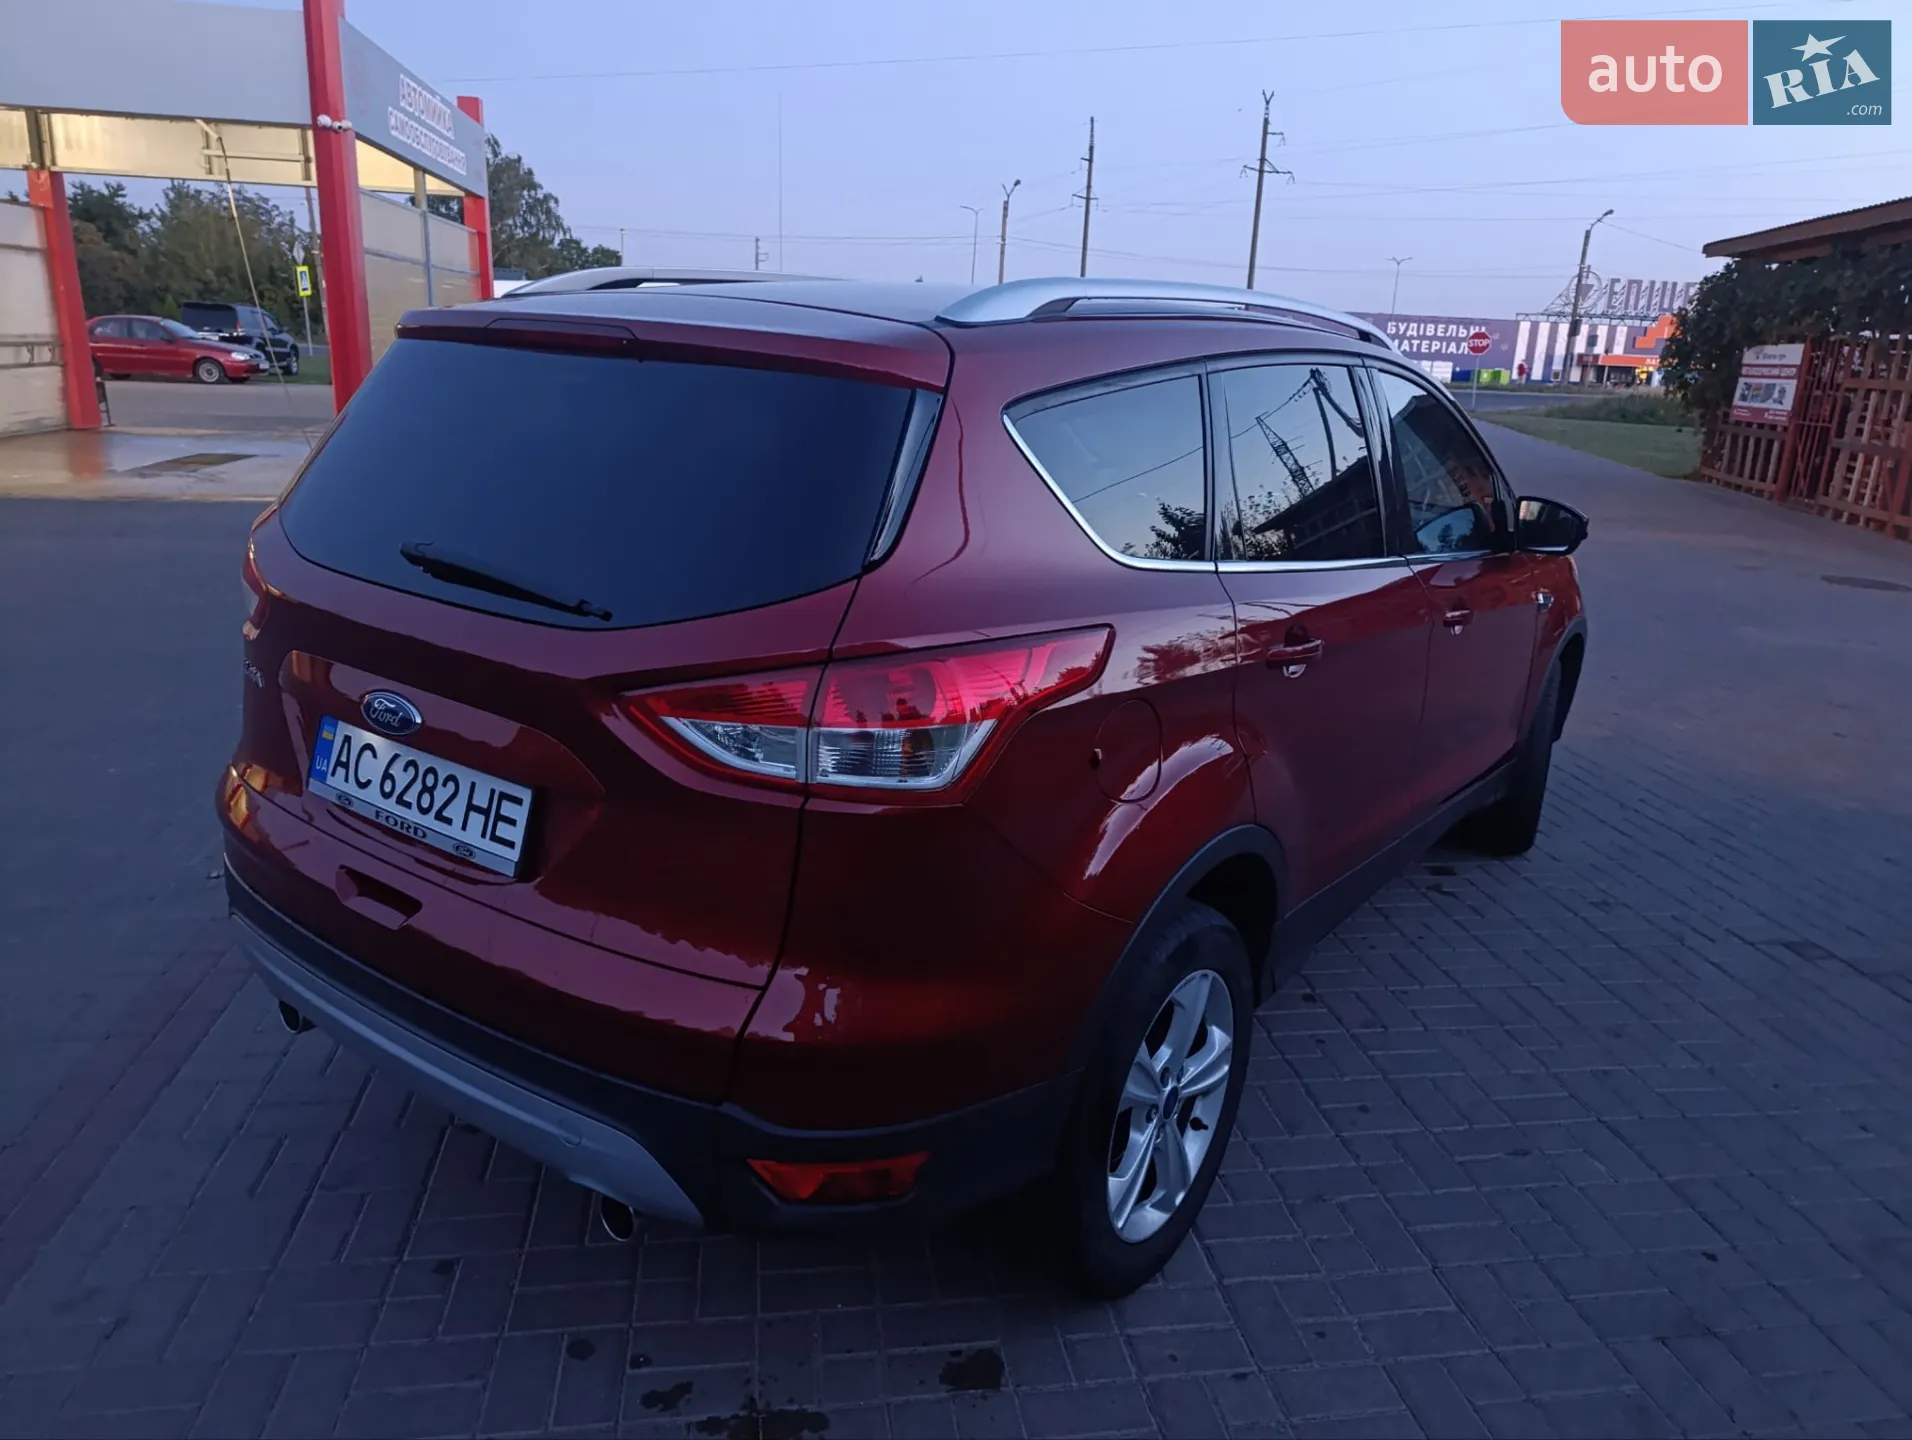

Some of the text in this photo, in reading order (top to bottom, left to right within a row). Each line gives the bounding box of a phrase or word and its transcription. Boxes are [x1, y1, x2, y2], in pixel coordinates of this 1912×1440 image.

[1392, 339, 1472, 355] АТЕРІАЛ
[1469, 338, 1489, 347] STOP
[369, 698, 403, 727] Ford
[315, 755, 328, 772] UA
[330, 734, 524, 850] AC 6282 HE
[374, 810, 427, 839] FORD
